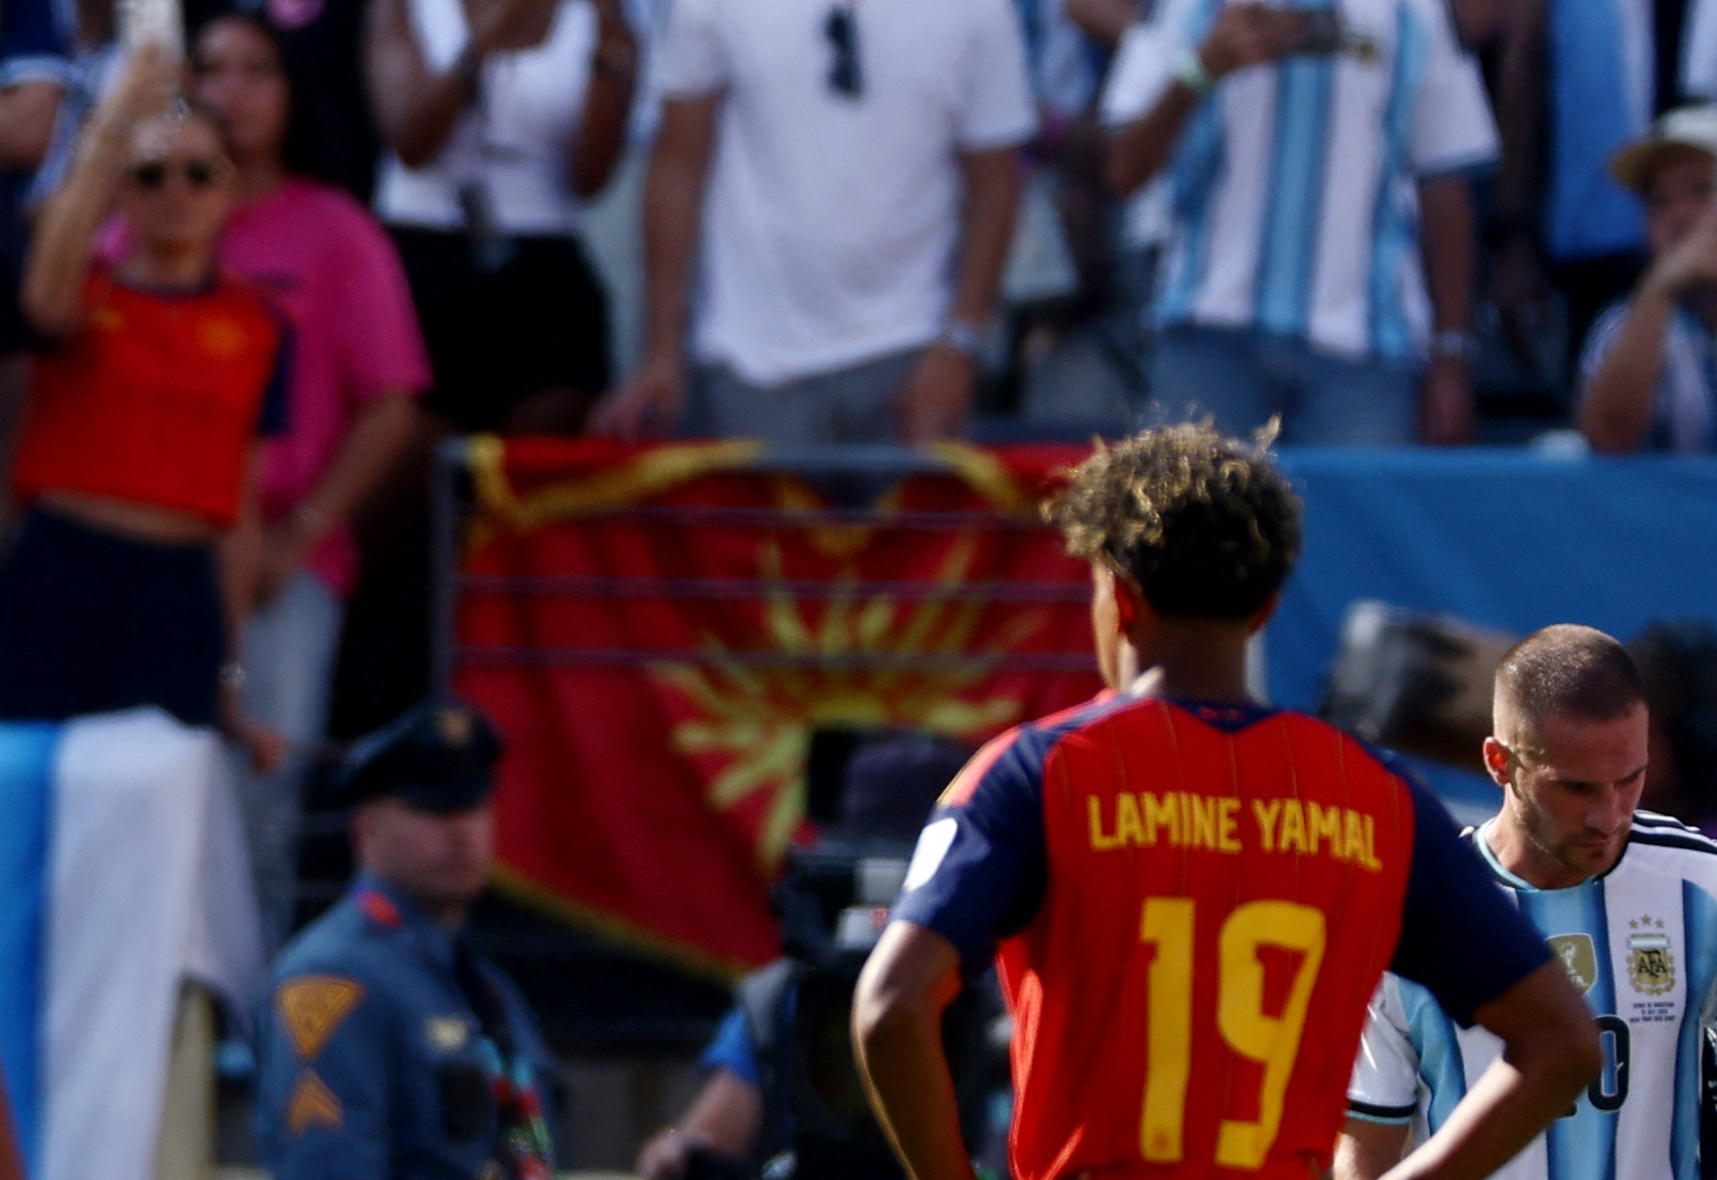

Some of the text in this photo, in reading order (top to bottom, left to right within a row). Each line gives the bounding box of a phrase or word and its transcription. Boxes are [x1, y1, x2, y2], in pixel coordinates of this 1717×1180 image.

[1087, 791, 1382, 872] LAMINE YAMAL
[1139, 897, 1326, 1171] 19
